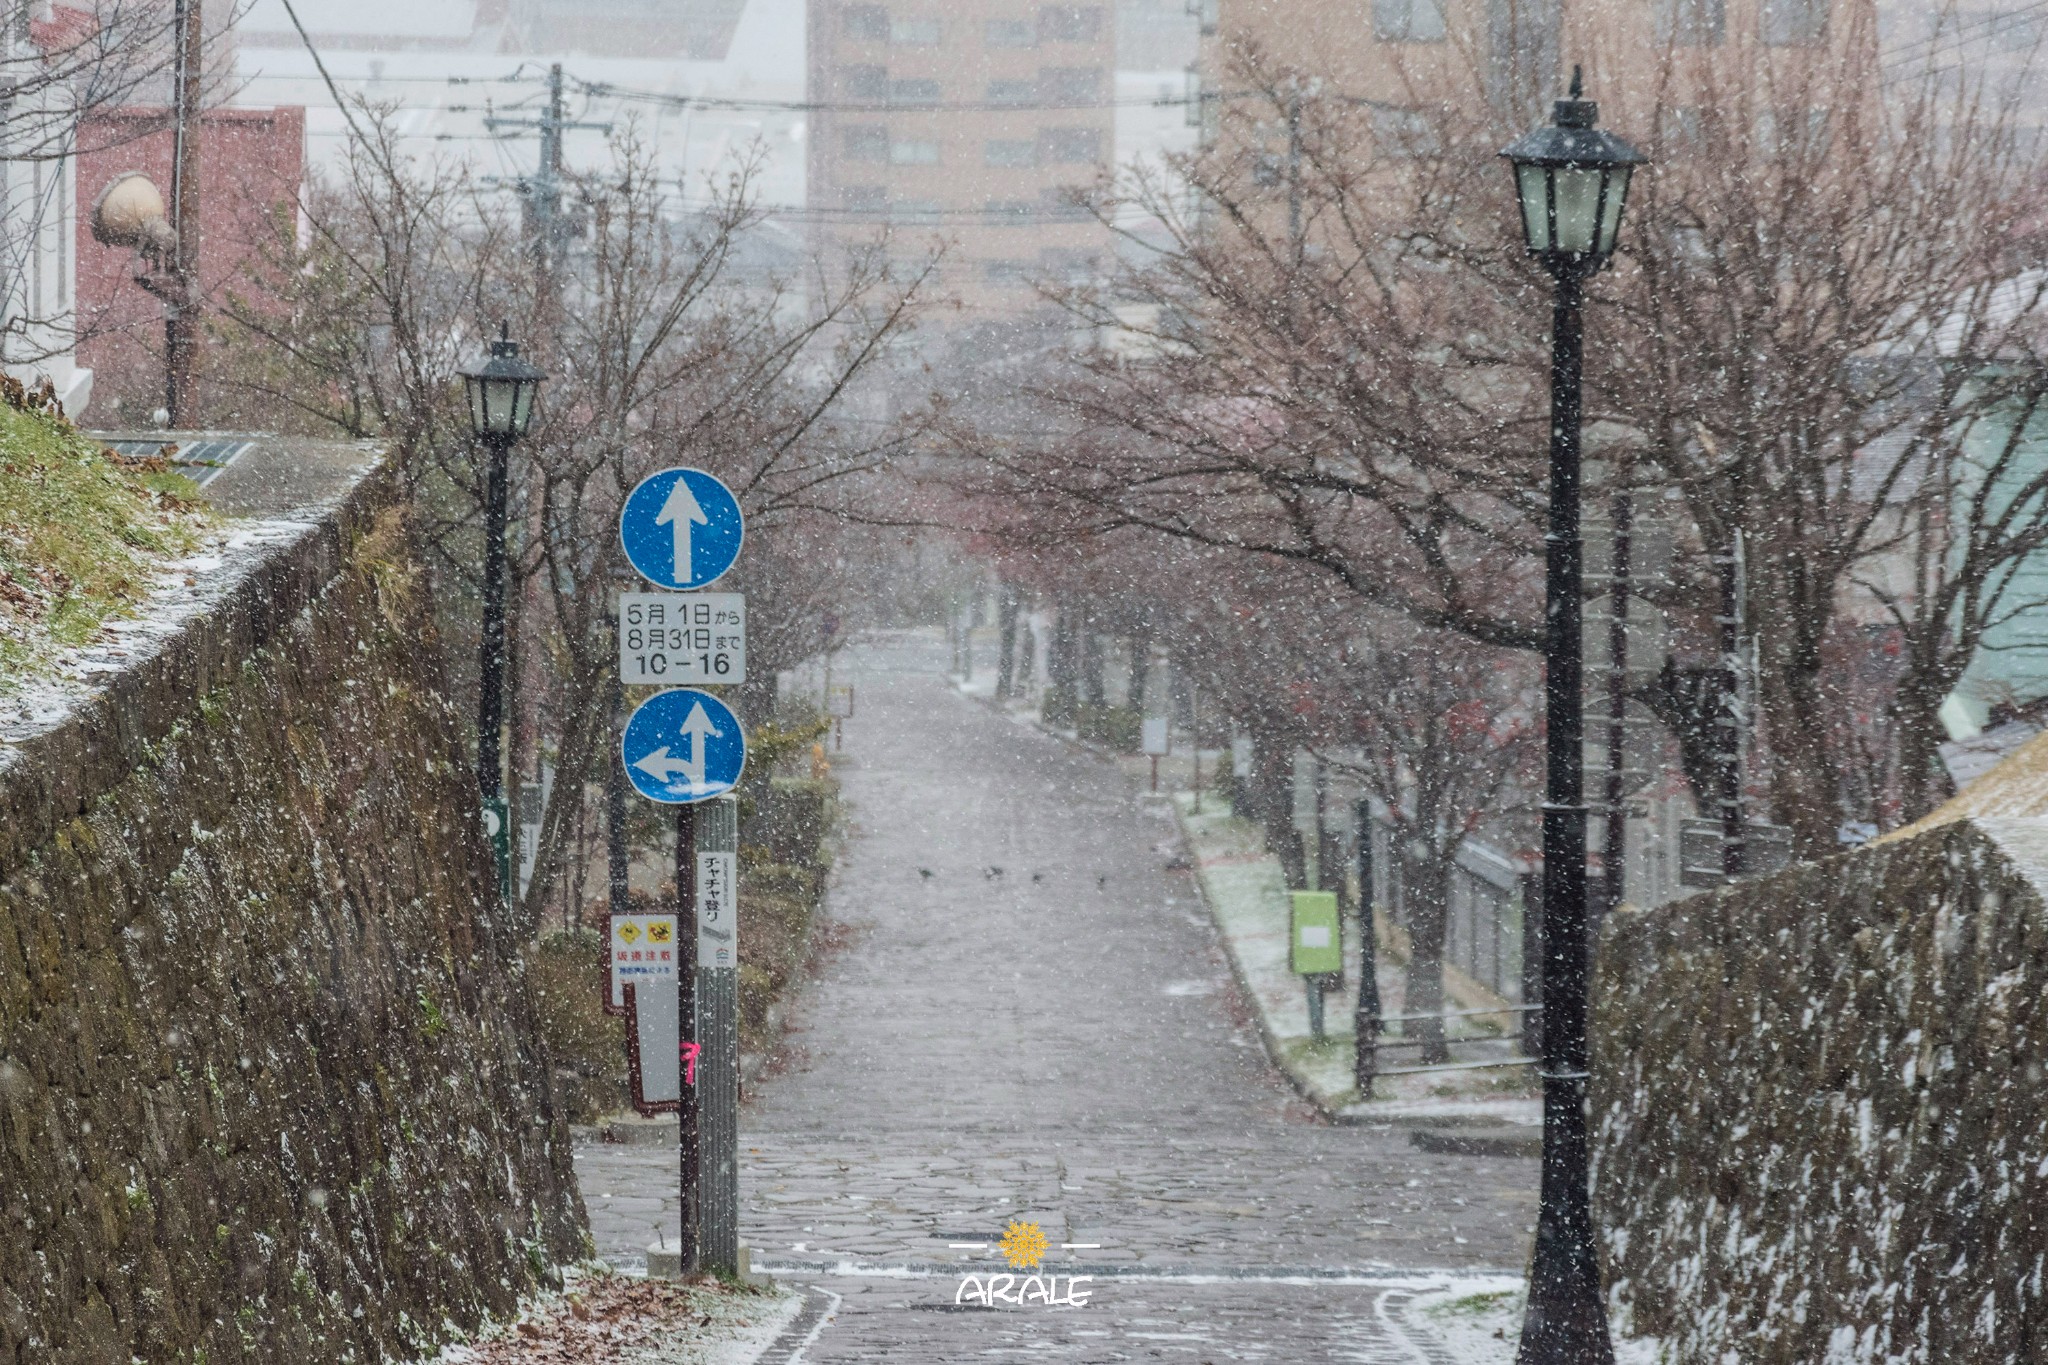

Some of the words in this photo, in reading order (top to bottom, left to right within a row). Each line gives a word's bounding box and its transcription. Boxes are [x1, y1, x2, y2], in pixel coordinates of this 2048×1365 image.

[627, 628, 741, 651] 8月31日まで
[704, 857, 721, 923] チャチャ登り
